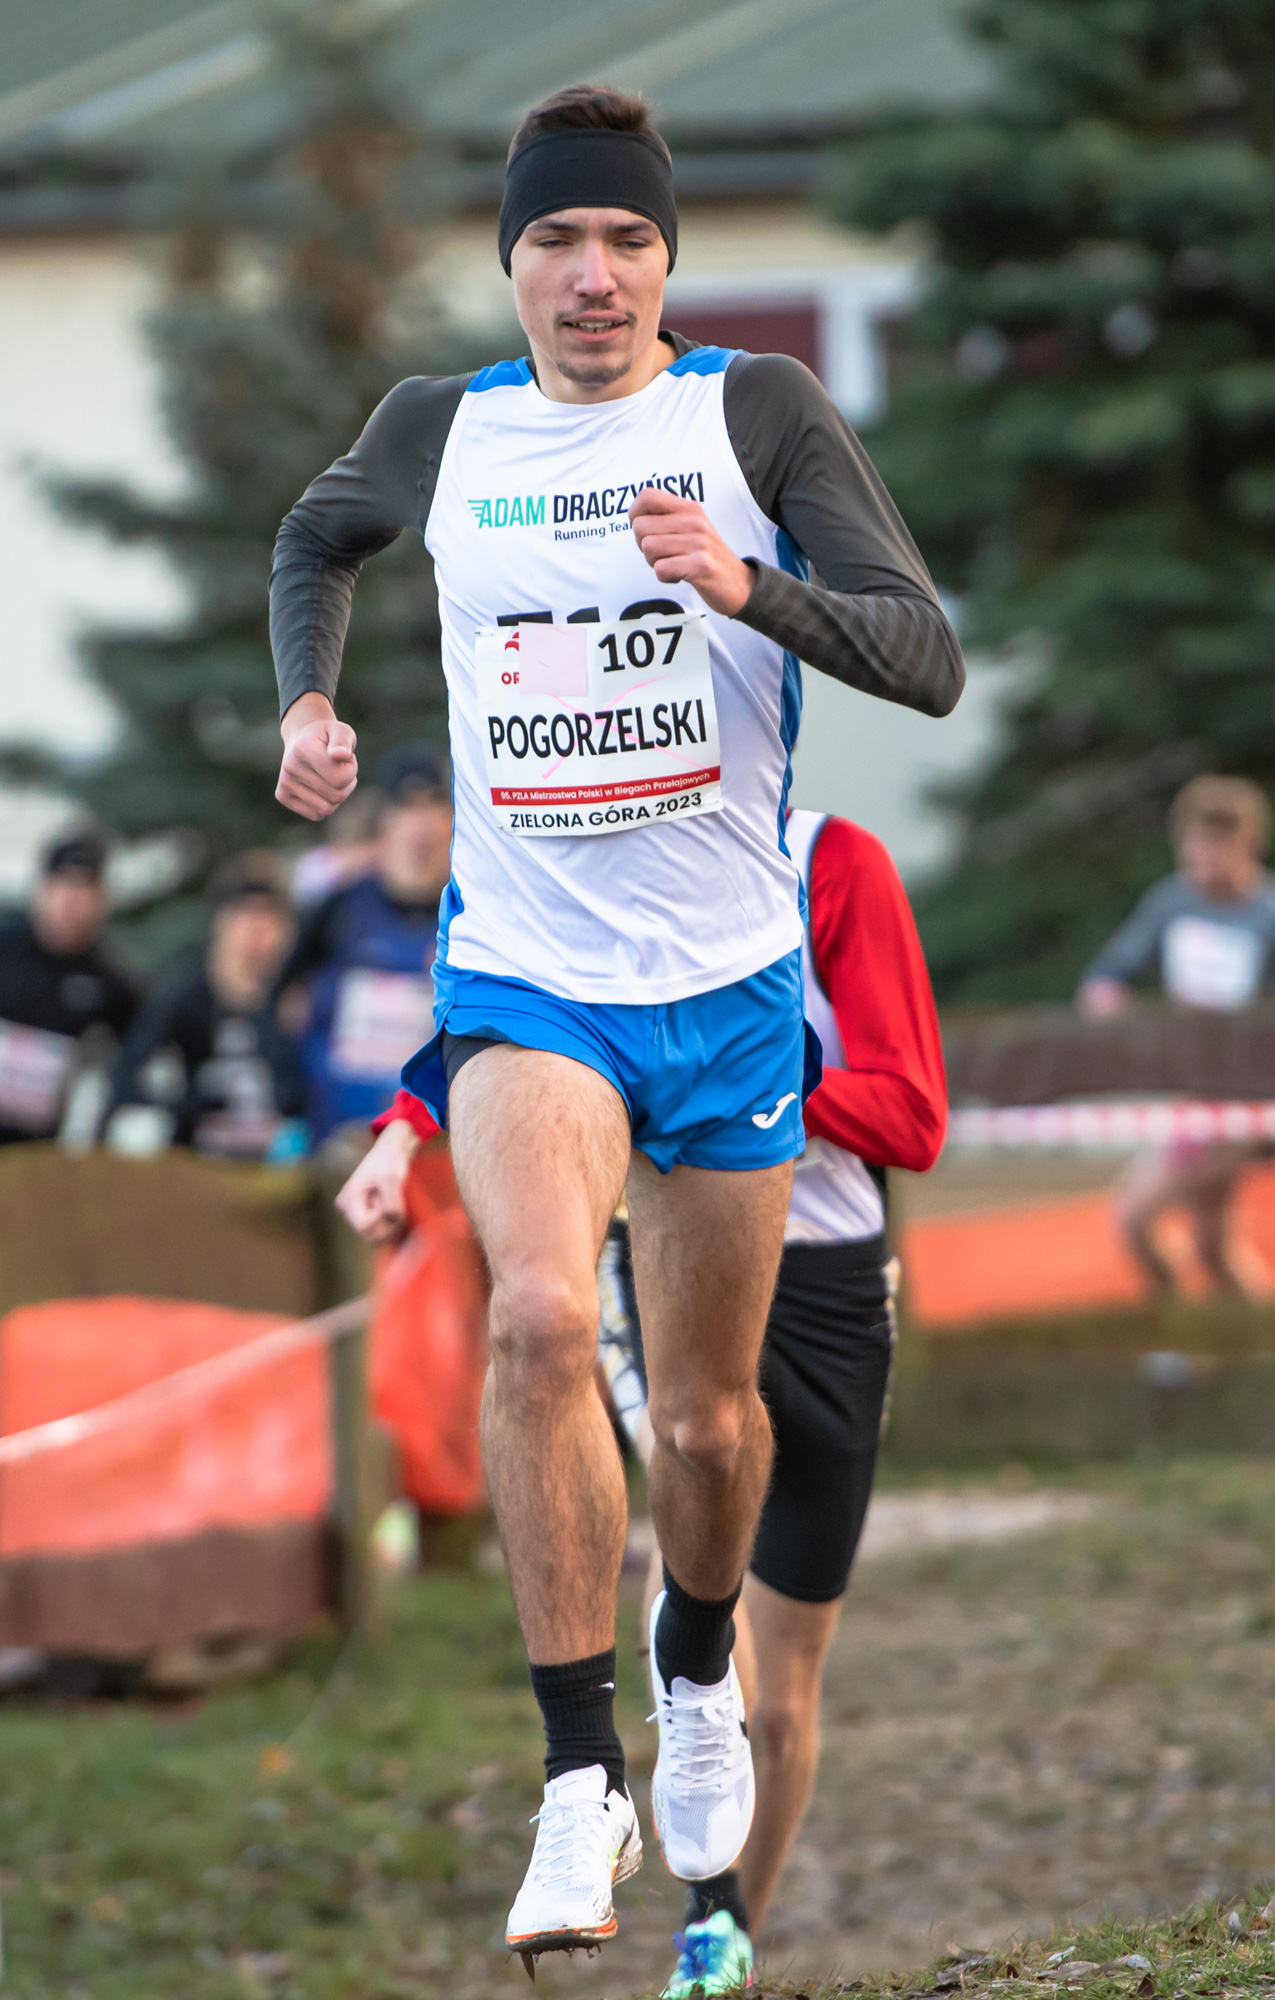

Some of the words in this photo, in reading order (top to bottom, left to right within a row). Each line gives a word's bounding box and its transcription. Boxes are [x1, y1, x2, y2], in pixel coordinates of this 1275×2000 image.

[468, 495, 545, 529] ADAM
[554, 526, 606, 541] Running
[609, 520, 633, 533] Tea
[597, 625, 684, 673] 107
[488, 698, 707, 759] POGORZELSKI
[512, 791, 529, 800] PZLA
[530, 790, 577, 800] Mistrzostwa
[578, 788, 603, 798] Polski
[614, 783, 652, 795] Biegach
[509, 812, 584, 828] ZIELONA
[588, 804, 651, 826] GÓRA
[655, 792, 702, 817] 2023
